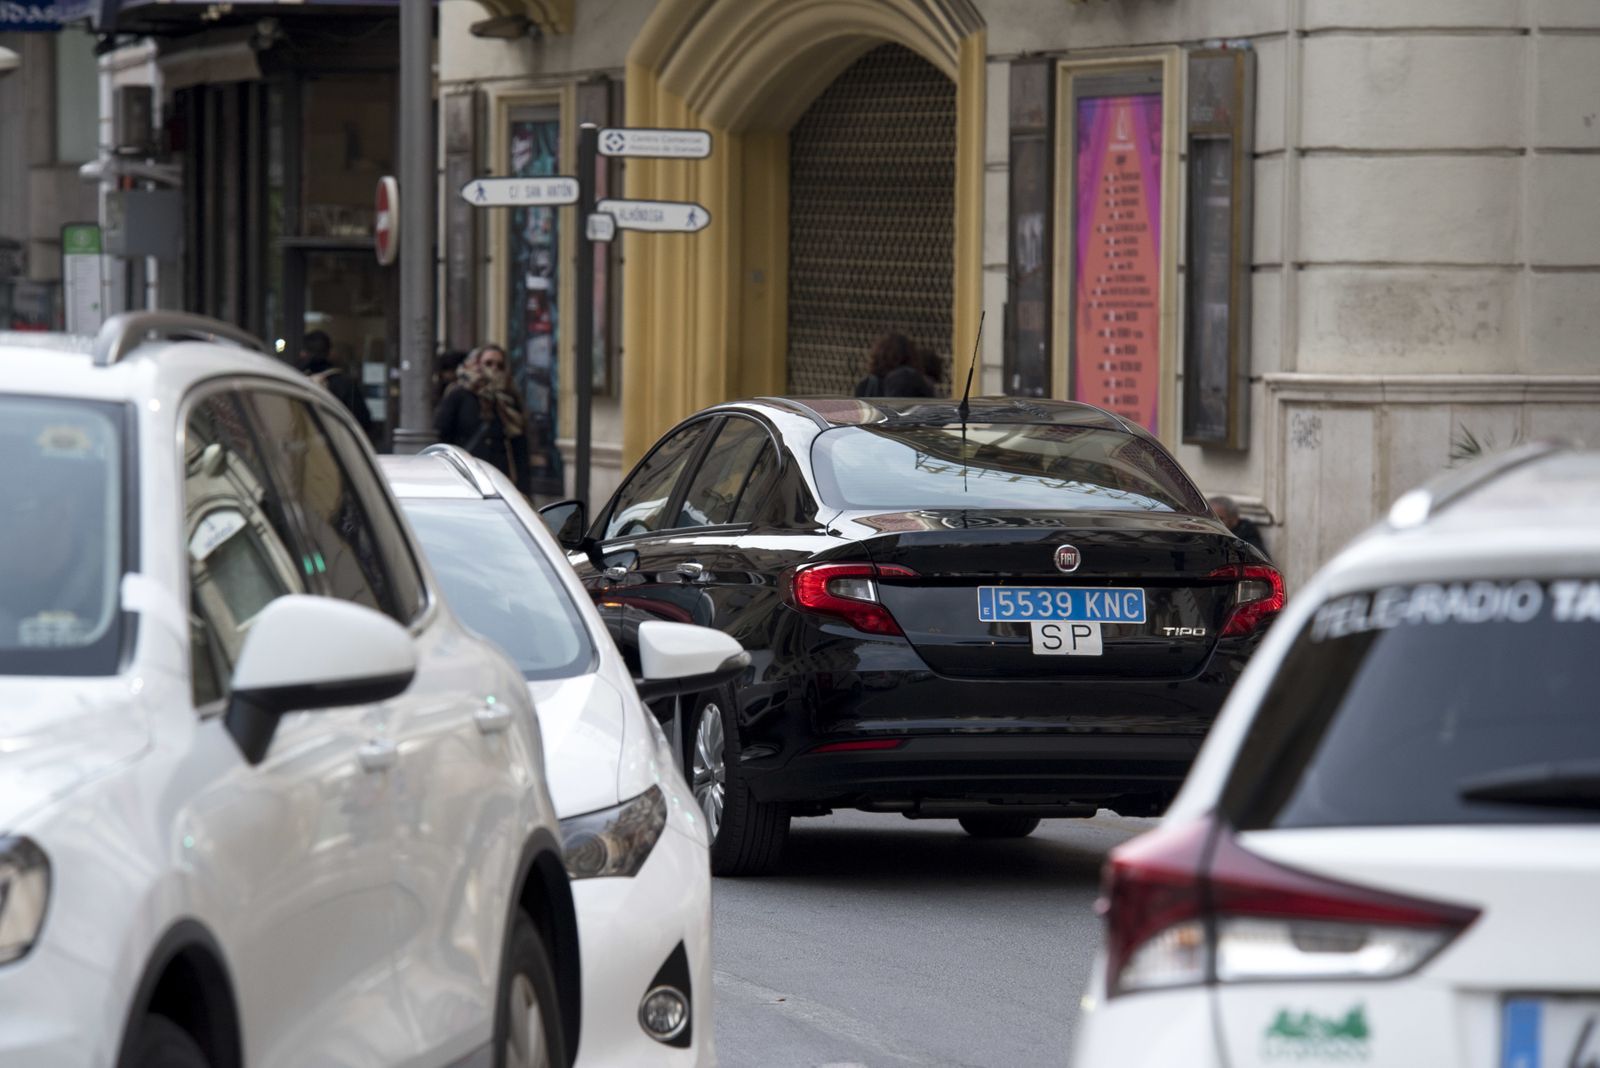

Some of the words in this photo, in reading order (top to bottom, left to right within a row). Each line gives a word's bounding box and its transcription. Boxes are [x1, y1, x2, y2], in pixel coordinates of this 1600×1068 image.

[525, 185, 541, 199] SAN
[1060, 552, 1075, 565] FIAT
[983, 607, 990, 615] E
[999, 591, 1073, 618] 5539
[1085, 592, 1140, 619] KNC
[1162, 626, 1206, 637] TIPO
